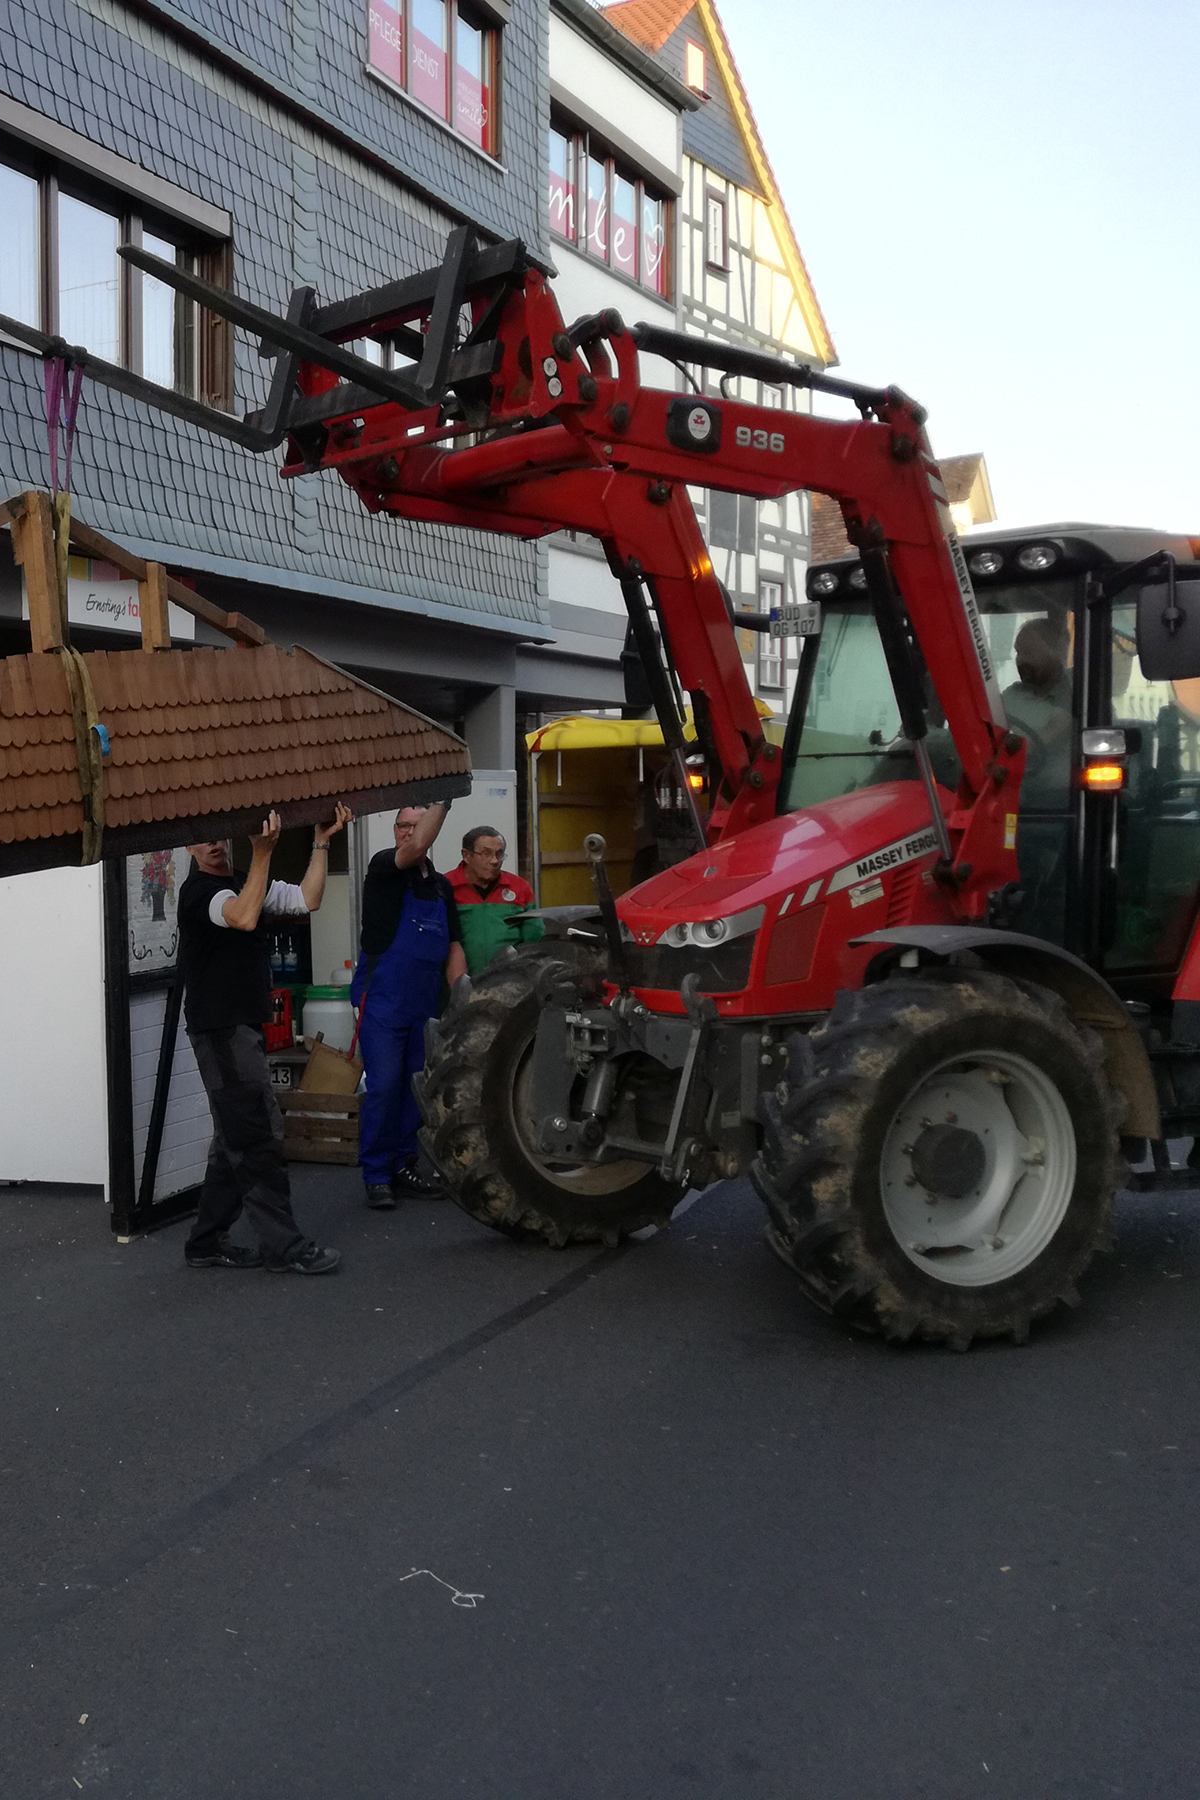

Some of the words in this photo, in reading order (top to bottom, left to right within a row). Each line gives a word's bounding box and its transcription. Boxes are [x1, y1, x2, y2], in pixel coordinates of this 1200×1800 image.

[369, 8, 402, 53] PFLEGE
[735, 426, 785, 453] 936
[85, 593, 127, 621] Ernsting's
[947, 531, 971, 595] MASSEY
[966, 599, 993, 683] FERGUSON
[773, 622, 789, 636] QG
[793, 619, 815, 634] 107
[856, 848, 903, 878] MASSEY
[271, 1069, 290, 1085] 13
